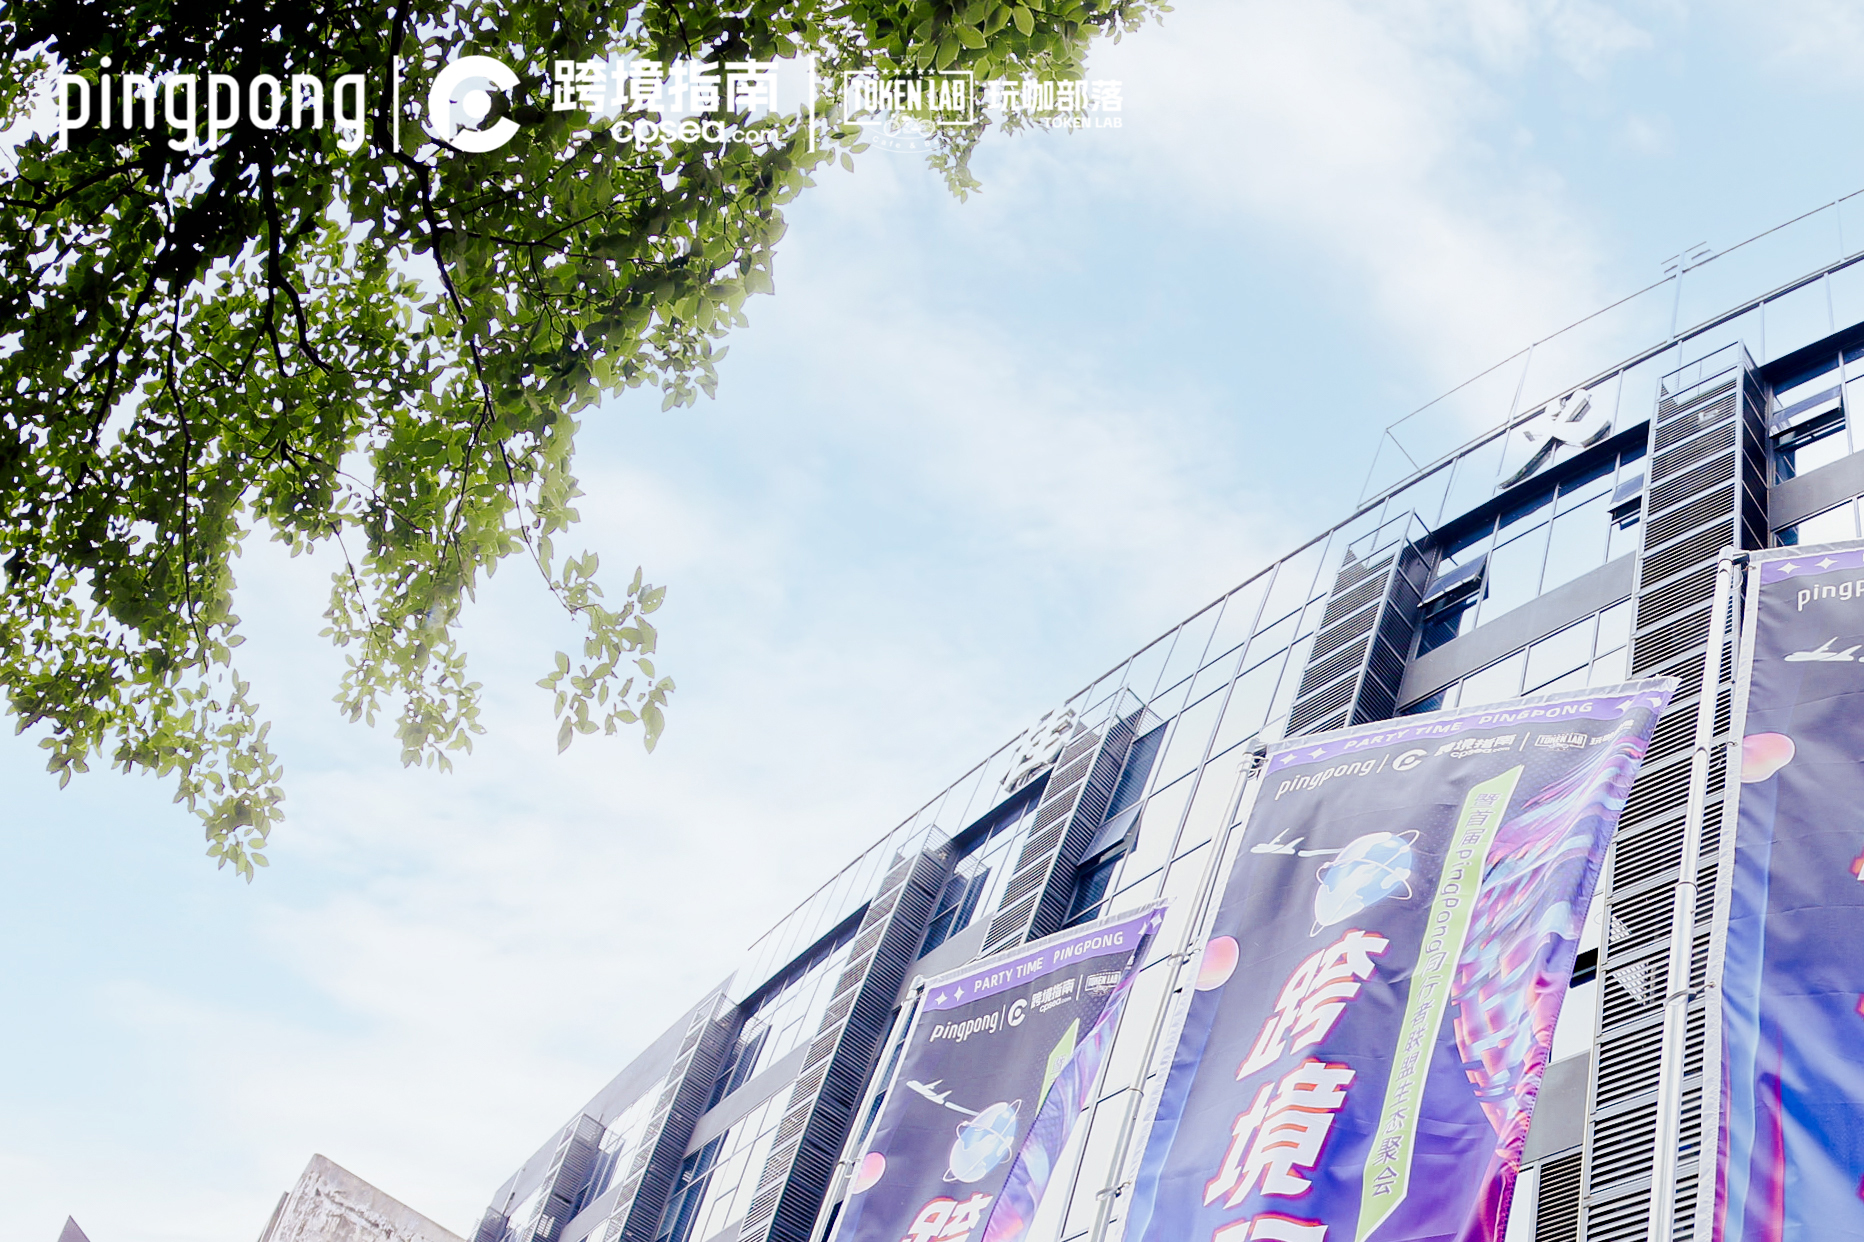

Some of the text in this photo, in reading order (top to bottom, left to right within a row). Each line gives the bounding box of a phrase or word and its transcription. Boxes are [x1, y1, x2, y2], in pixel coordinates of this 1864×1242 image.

[1342, 701, 1594, 751] PARTY TIME PINGPONG
[1274, 756, 1376, 800] pingpong
[973, 968, 1014, 992] PARTY
[1016, 956, 1043, 979] TIME
[1052, 931, 1124, 964] PINGPONG
[929, 1010, 999, 1043] pingpong
